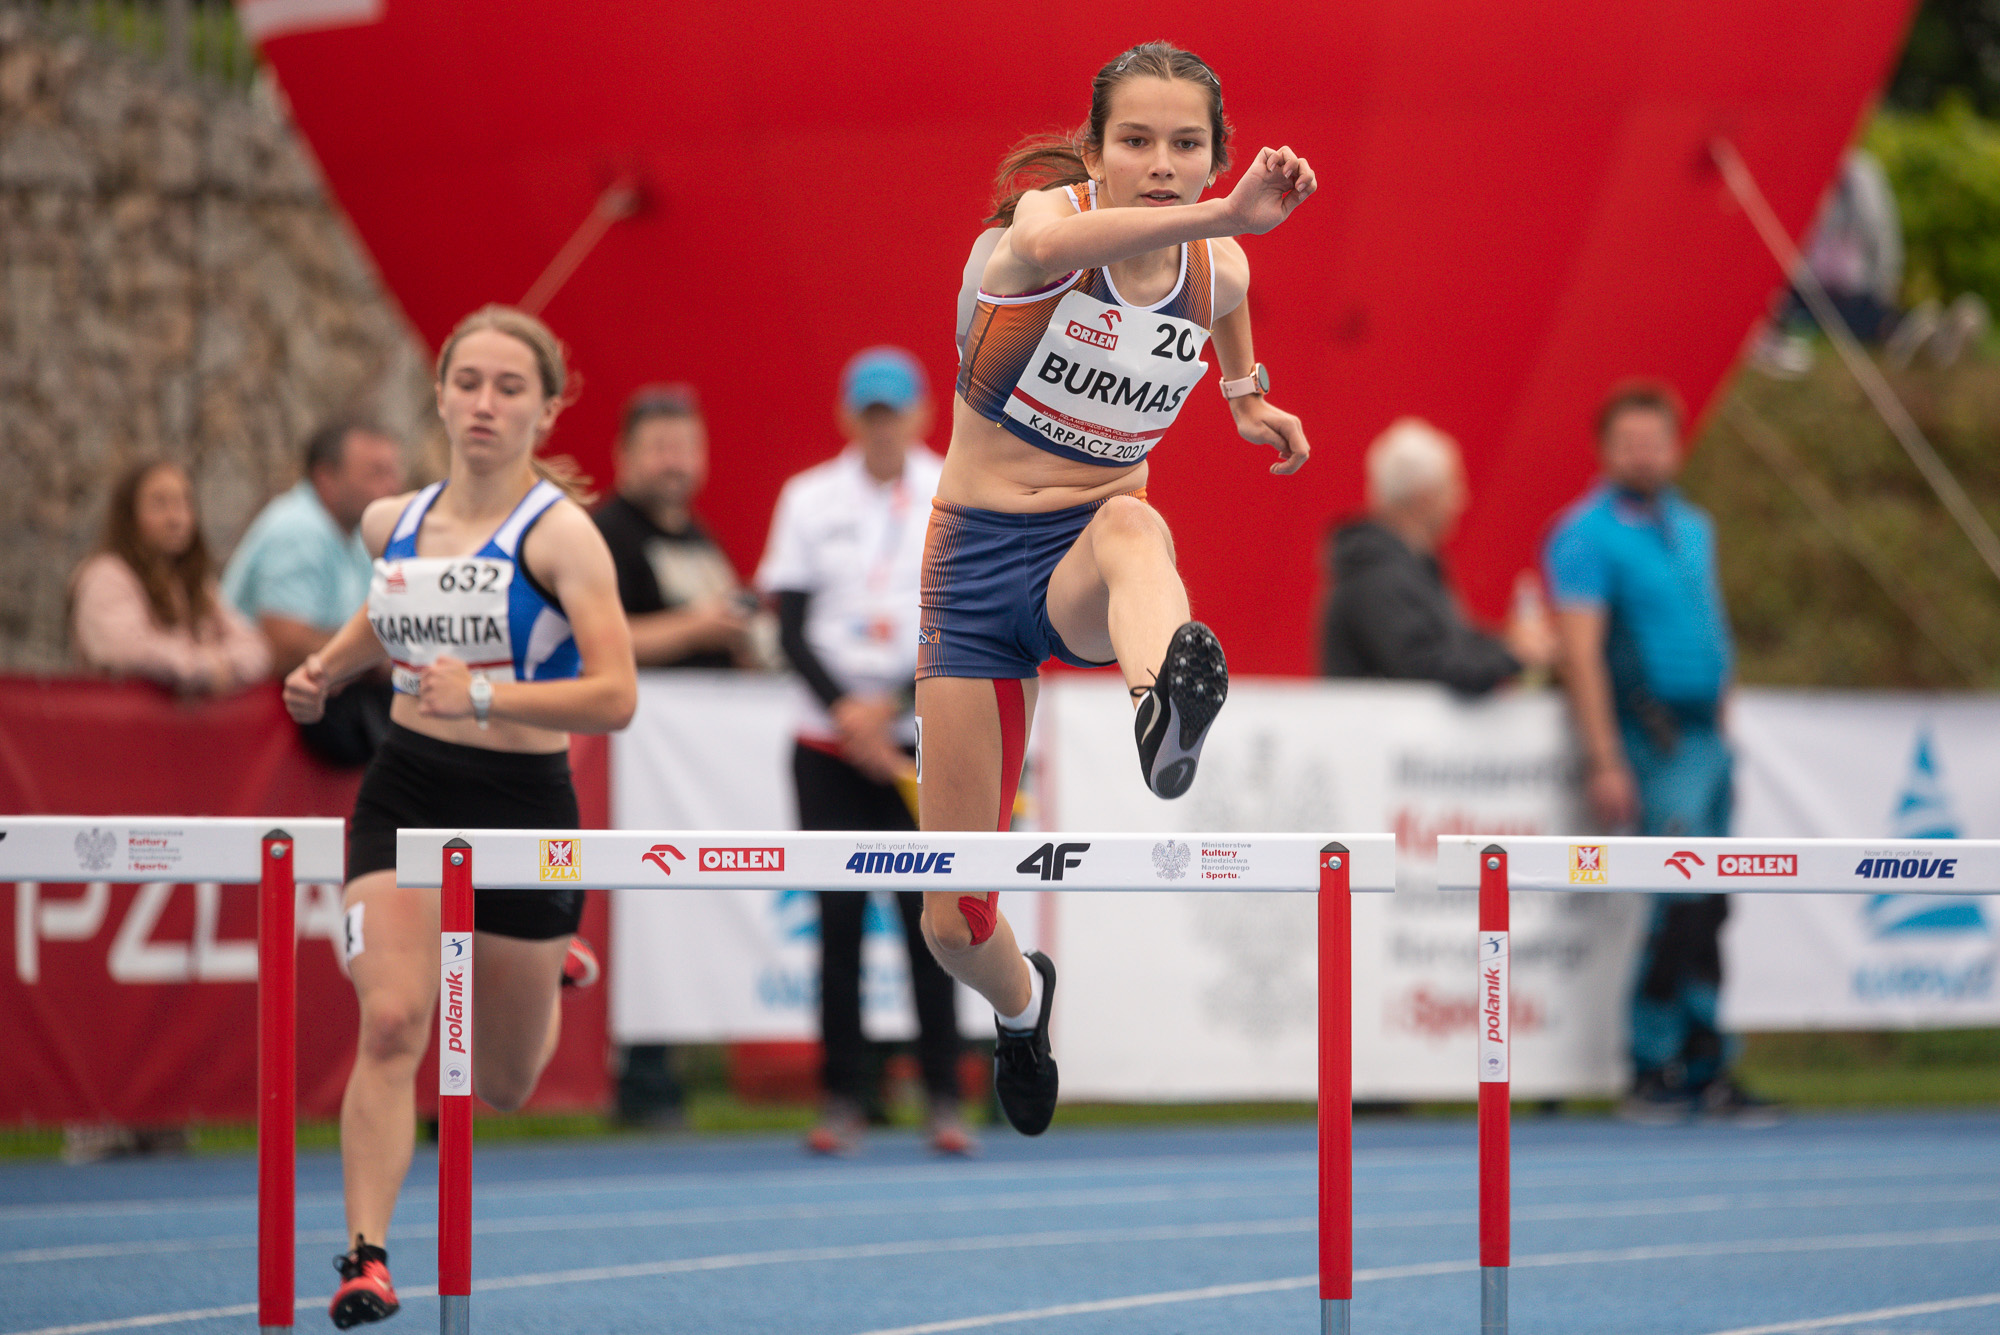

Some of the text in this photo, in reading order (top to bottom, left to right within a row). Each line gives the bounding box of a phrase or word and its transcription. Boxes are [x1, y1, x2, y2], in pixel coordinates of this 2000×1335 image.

[1069, 324, 1117, 349] ORLEN
[1037, 351, 1189, 414] BURMAS
[1028, 413, 1145, 459] KARPACZ 2021
[439, 564, 499, 593] 632
[702, 850, 780, 869] ORLEN
[846, 852, 955, 874] 4MOVE
[1016, 842, 1091, 881] 4F
[1201, 849, 1238, 858] Kultury
[1720, 856, 1793, 875] ORLEN
[541, 867, 579, 880] PZLA
[1854, 858, 1958, 879] 4MOVE
[445, 970, 466, 1054] polanik
[1483, 967, 1504, 1044] polanik
